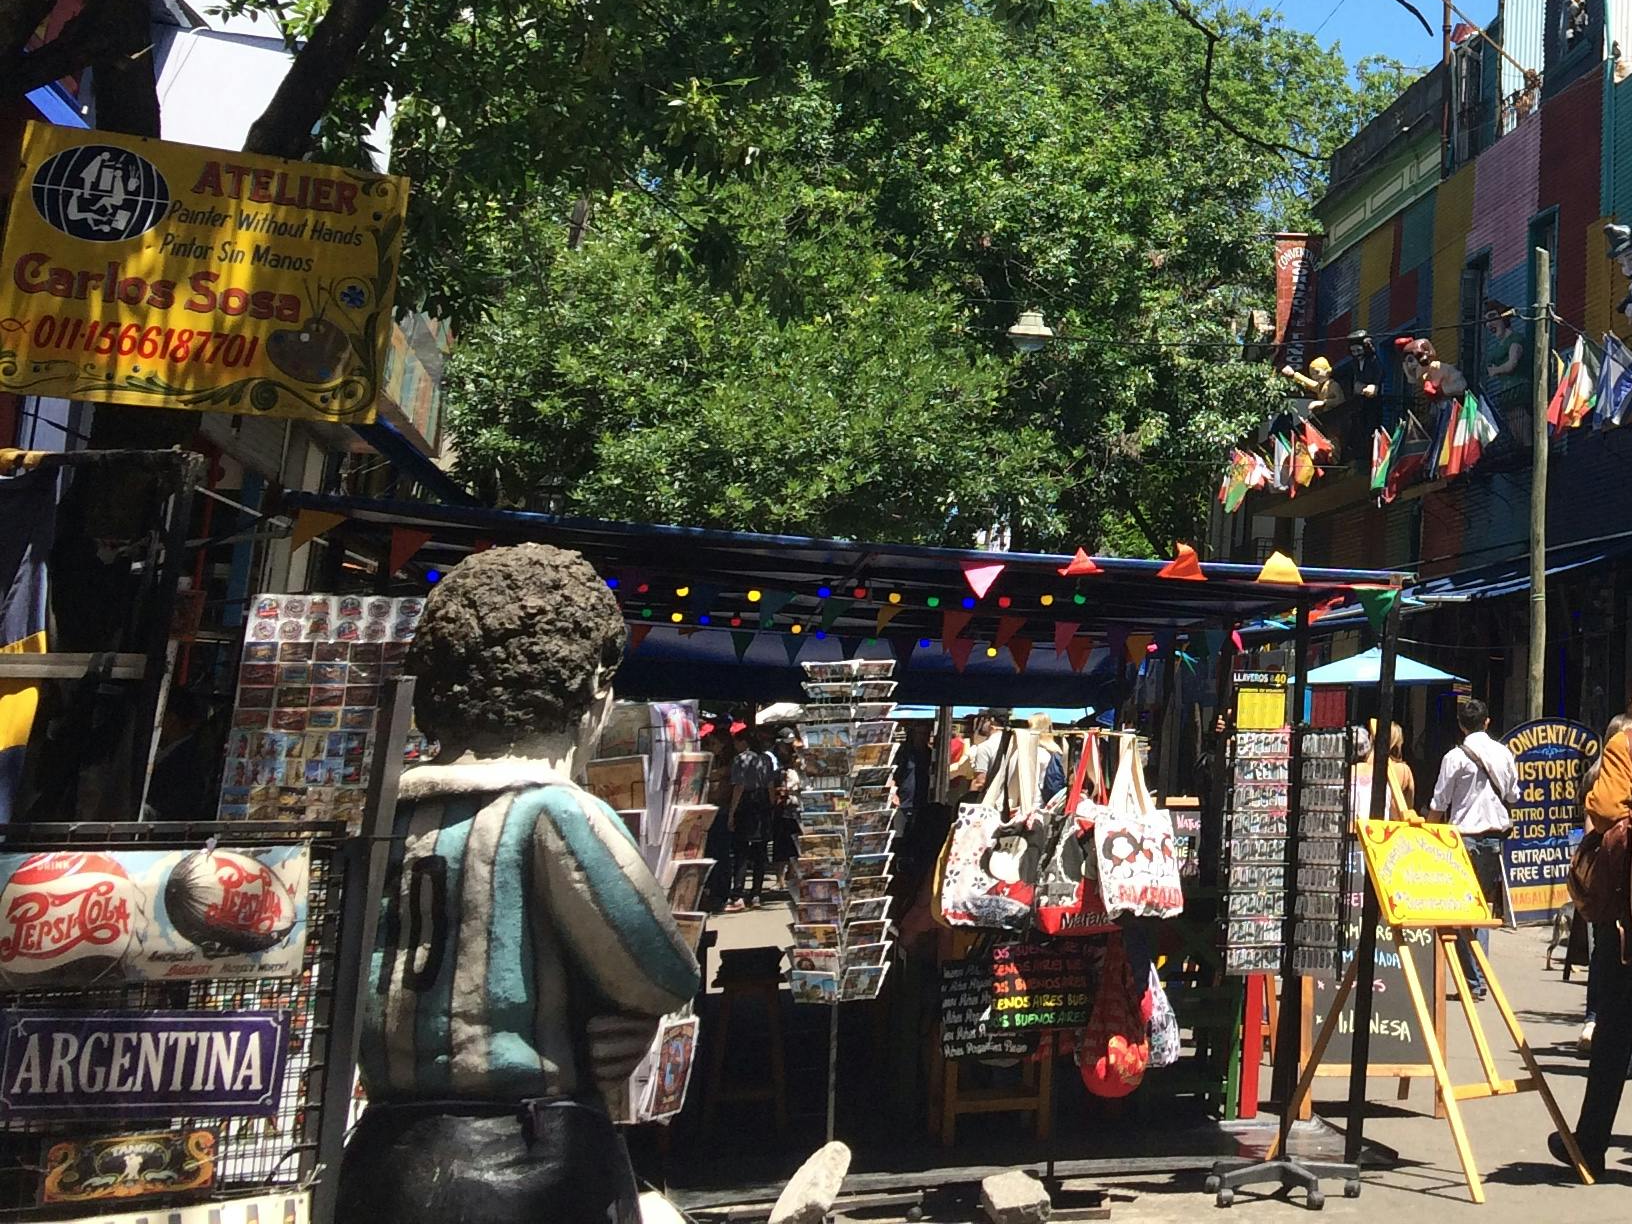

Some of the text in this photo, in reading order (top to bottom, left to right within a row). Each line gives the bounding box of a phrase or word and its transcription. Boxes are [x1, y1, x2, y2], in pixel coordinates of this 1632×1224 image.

[190, 160, 359, 216] ATELIER
[168, 201, 364, 248] Painter Without Hands
[159, 233, 315, 273] Pintor Sin Manos
[13, 251, 301, 324] Carlos Sosa
[1507, 723, 1599, 757] ONVENTILLO
[1523, 782, 1545, 803] de
[1510, 806, 1545, 822] ENTRO
[1523, 824, 1546, 839] LOS
[1511, 846, 1563, 865] ENTRADA
[1509, 865, 1540, 883] FREE
[1033, 994, 1064, 1009] AIRES
[1014, 1011, 1056, 1027] BUENOS
[9, 1030, 264, 1094] ARGENTINA
[109, 1141, 157, 1157] TANGO
